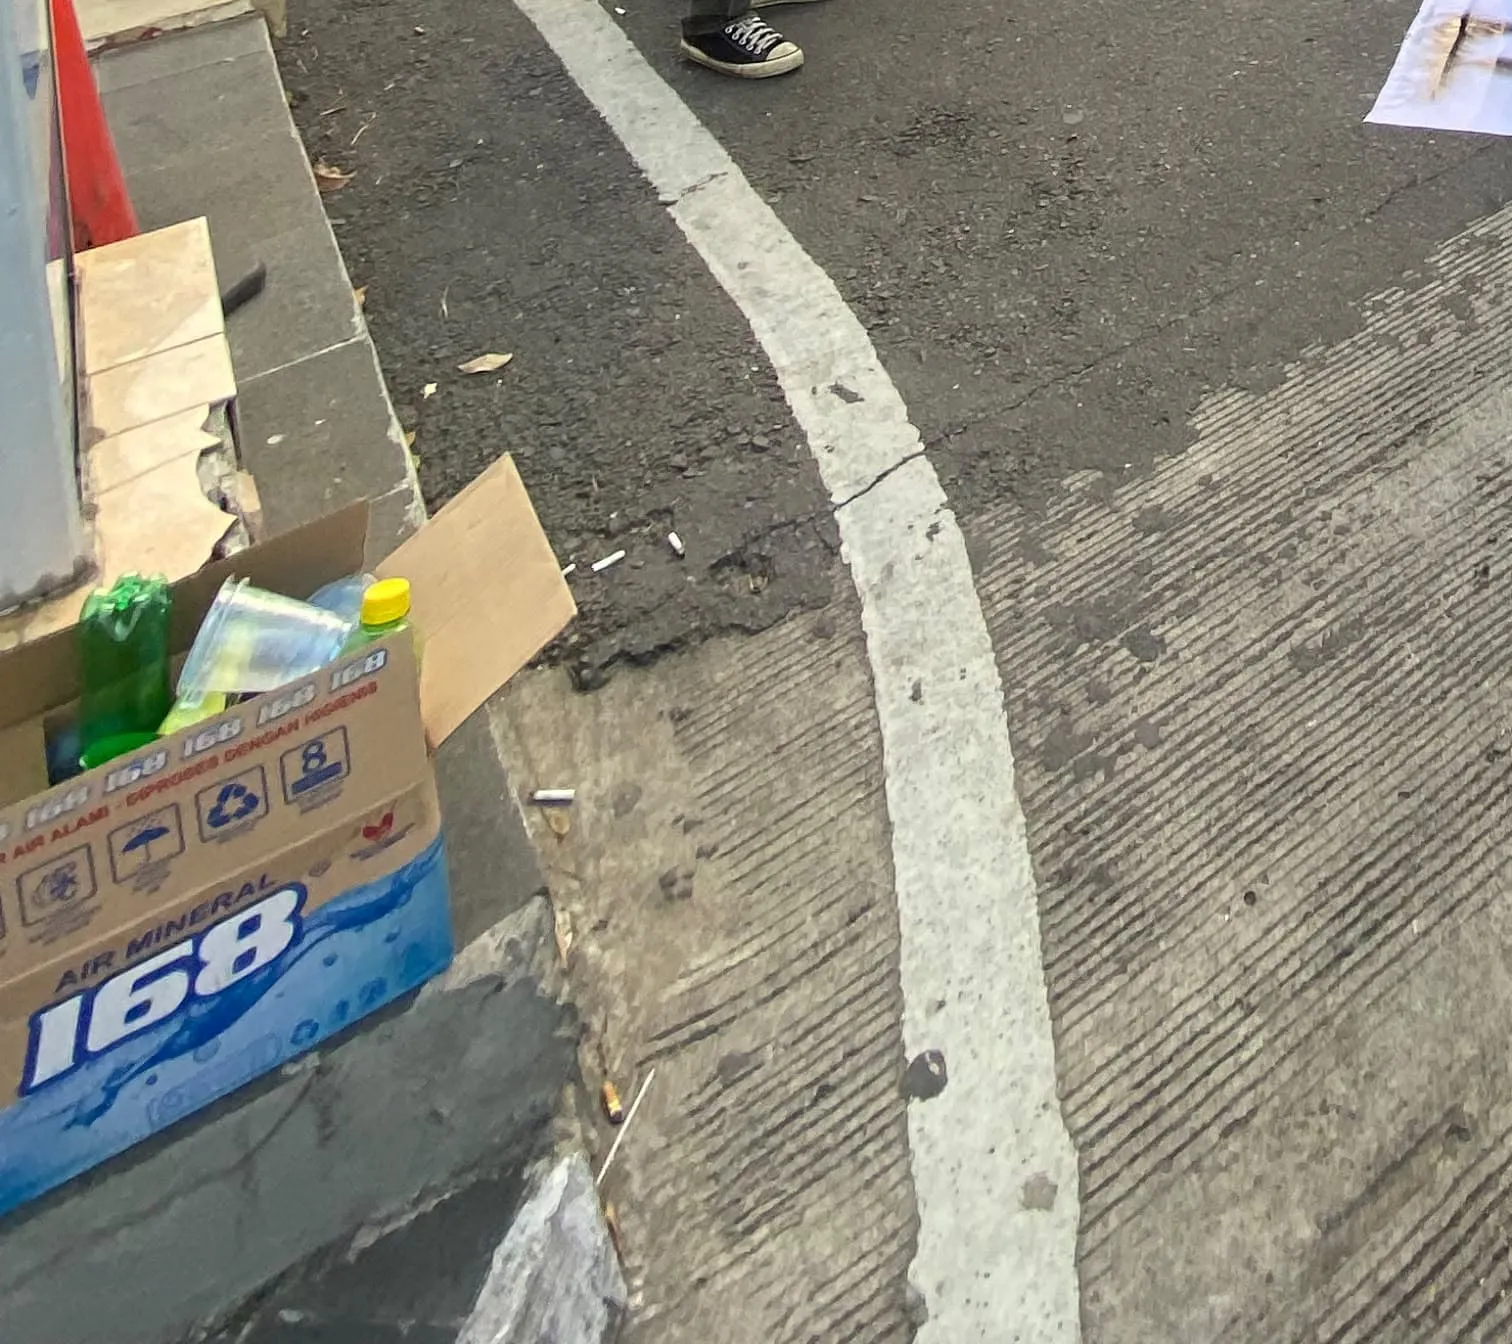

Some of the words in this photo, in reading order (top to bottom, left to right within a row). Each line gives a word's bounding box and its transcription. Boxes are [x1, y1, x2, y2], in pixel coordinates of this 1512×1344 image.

[330, 648, 388, 693] 168
[182, 718, 244, 760] 168
[56, 949, 115, 994] AIR
[125, 872, 282, 960] MINERAL
[22, 885, 303, 1094] 168
